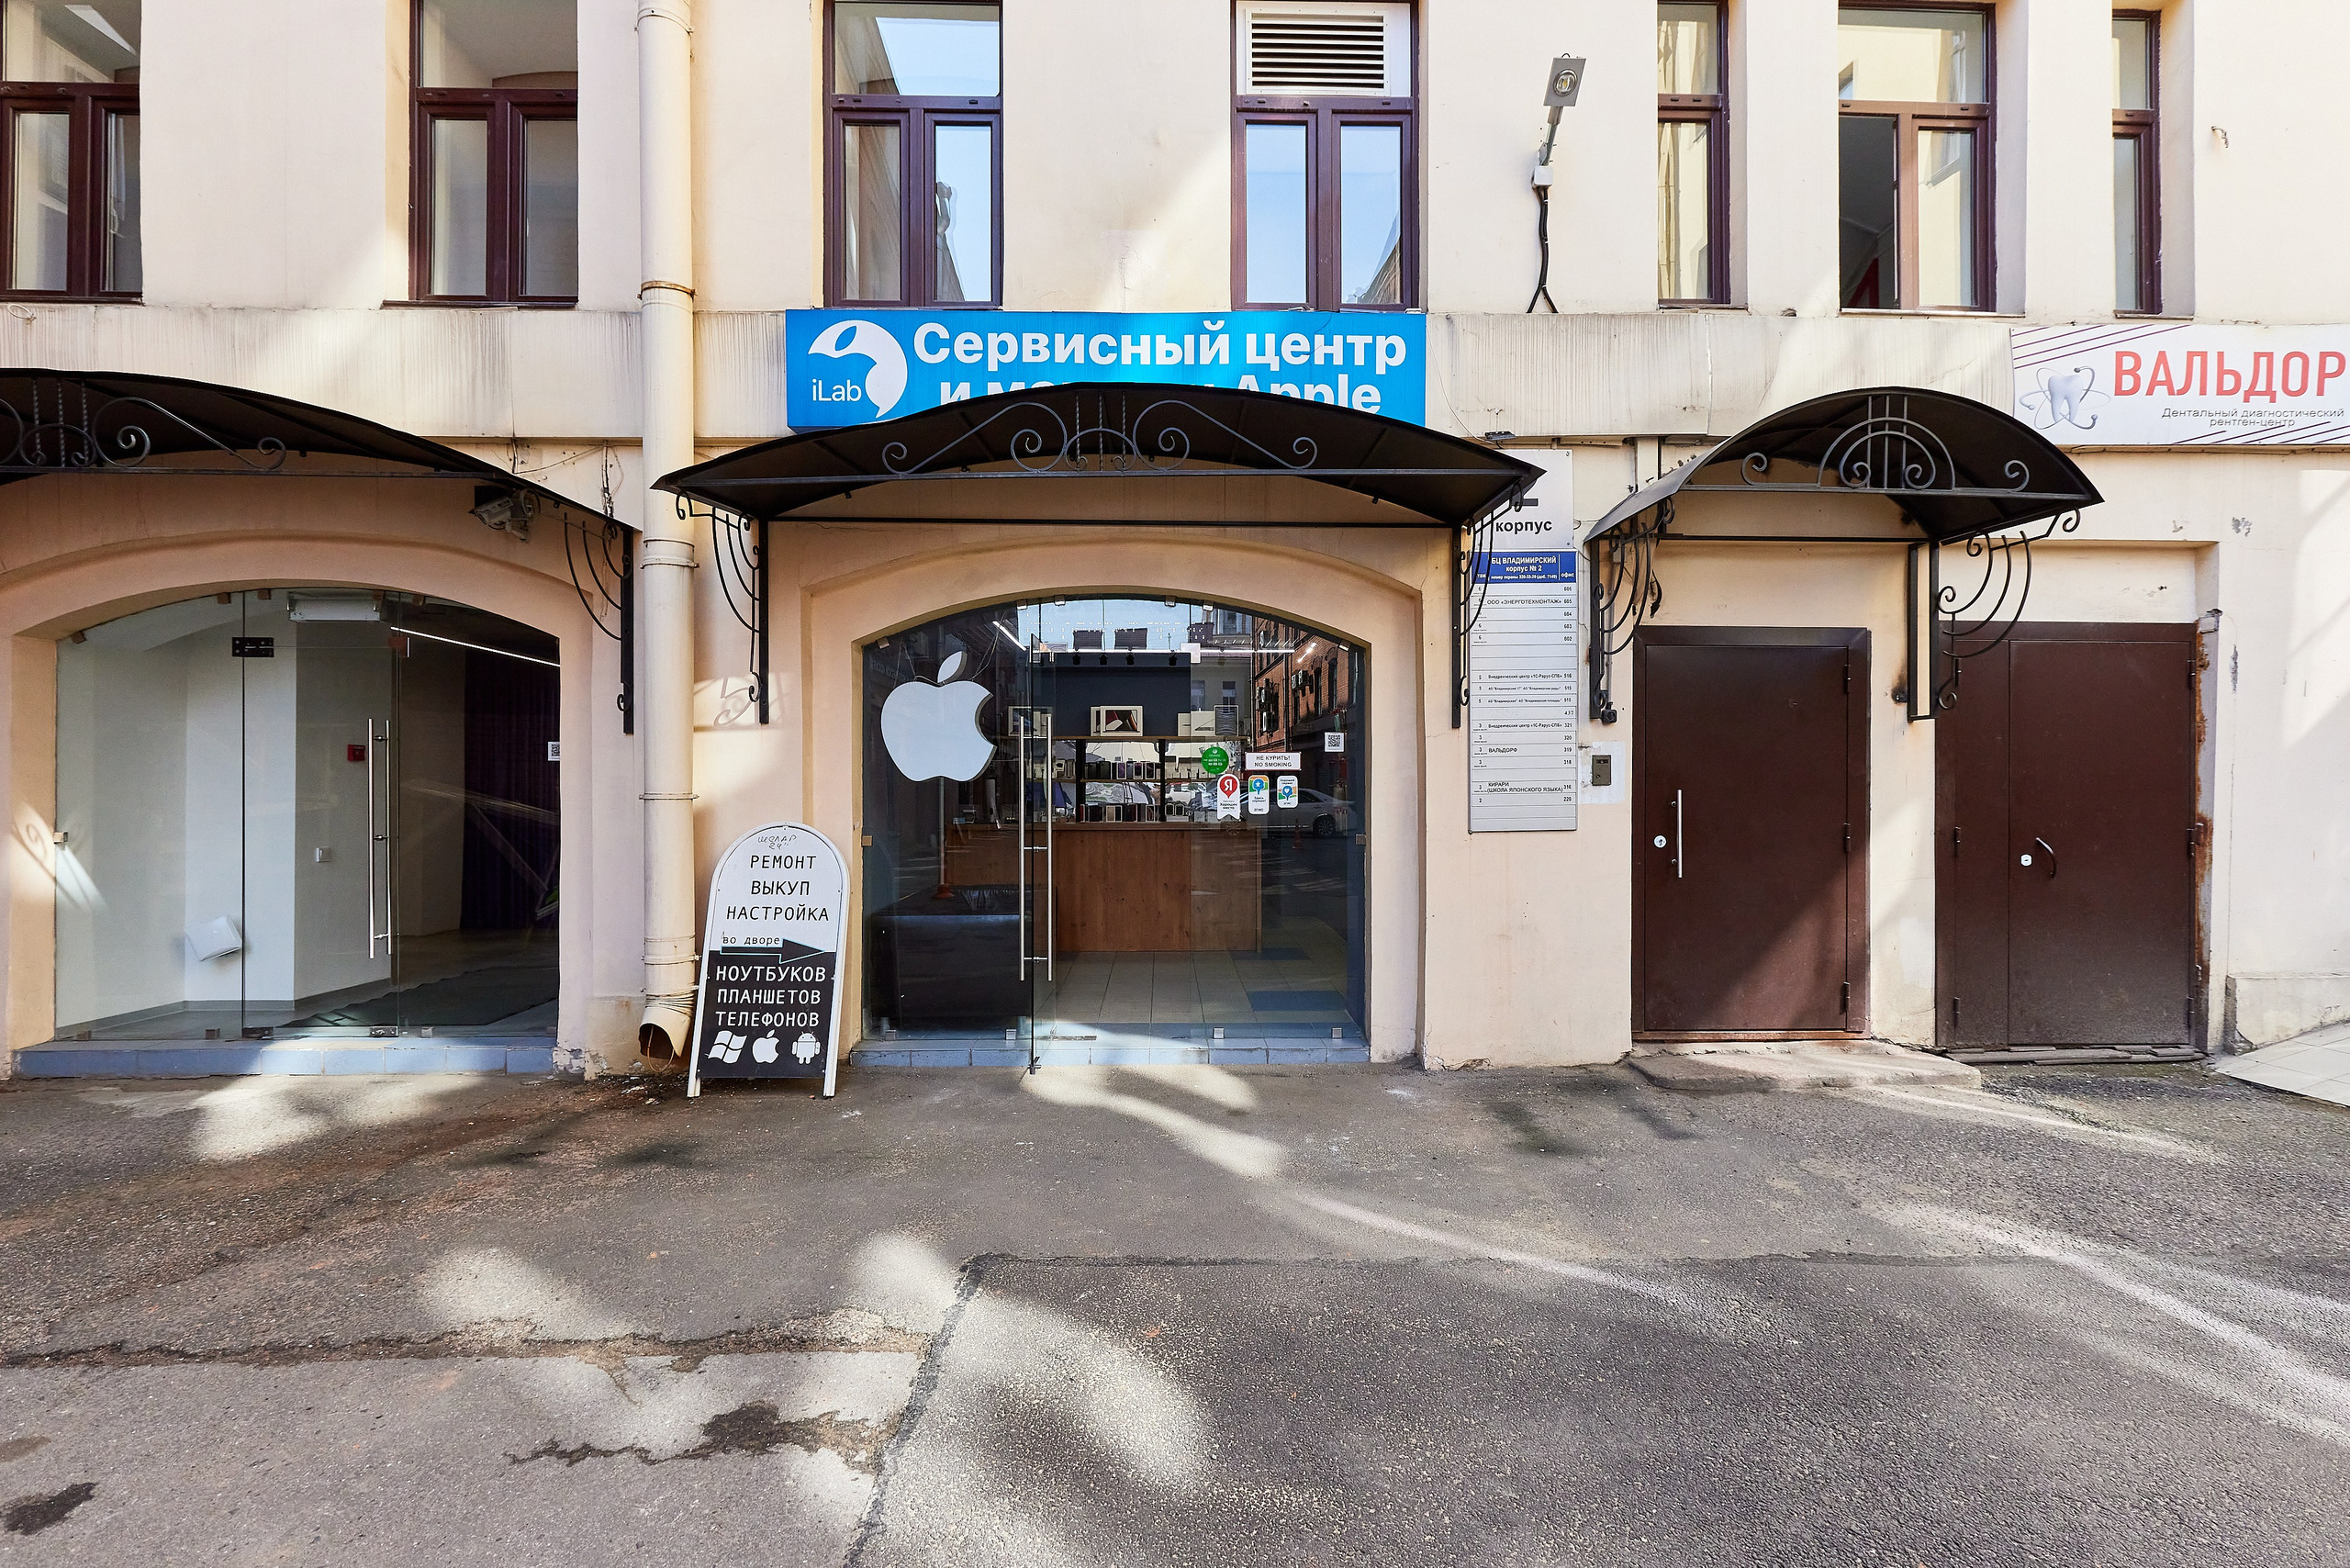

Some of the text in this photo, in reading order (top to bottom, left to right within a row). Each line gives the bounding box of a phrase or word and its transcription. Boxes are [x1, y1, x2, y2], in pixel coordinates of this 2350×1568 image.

[914, 319, 1407, 375] Сервисный центр
[2113, 350, 2347, 403] ВАЛЬДОР
[811, 380, 862, 402] iLab
[2161, 408, 2344, 419] Дентальный диагностический
[2210, 418, 2295, 428] рентген-центр
[1495, 521, 1553, 534] корпус
[1491, 555, 1557, 566] БЦ ВЛАДИМИРСКИЙ
[1224, 779, 1233, 790] Я
[750, 855, 817, 870] РЕМОНТ
[751, 880, 811, 896] ВЫКУП
[726, 902, 830, 922] НАСТРОЙКА
[722, 935, 780, 946] во дворе
[715, 965, 826, 983] НОУТБУКОВ
[717, 989, 822, 1005] ПЛАНШЕТОВ
[715, 1010, 820, 1027] ТЕЛЕФОНОВ
